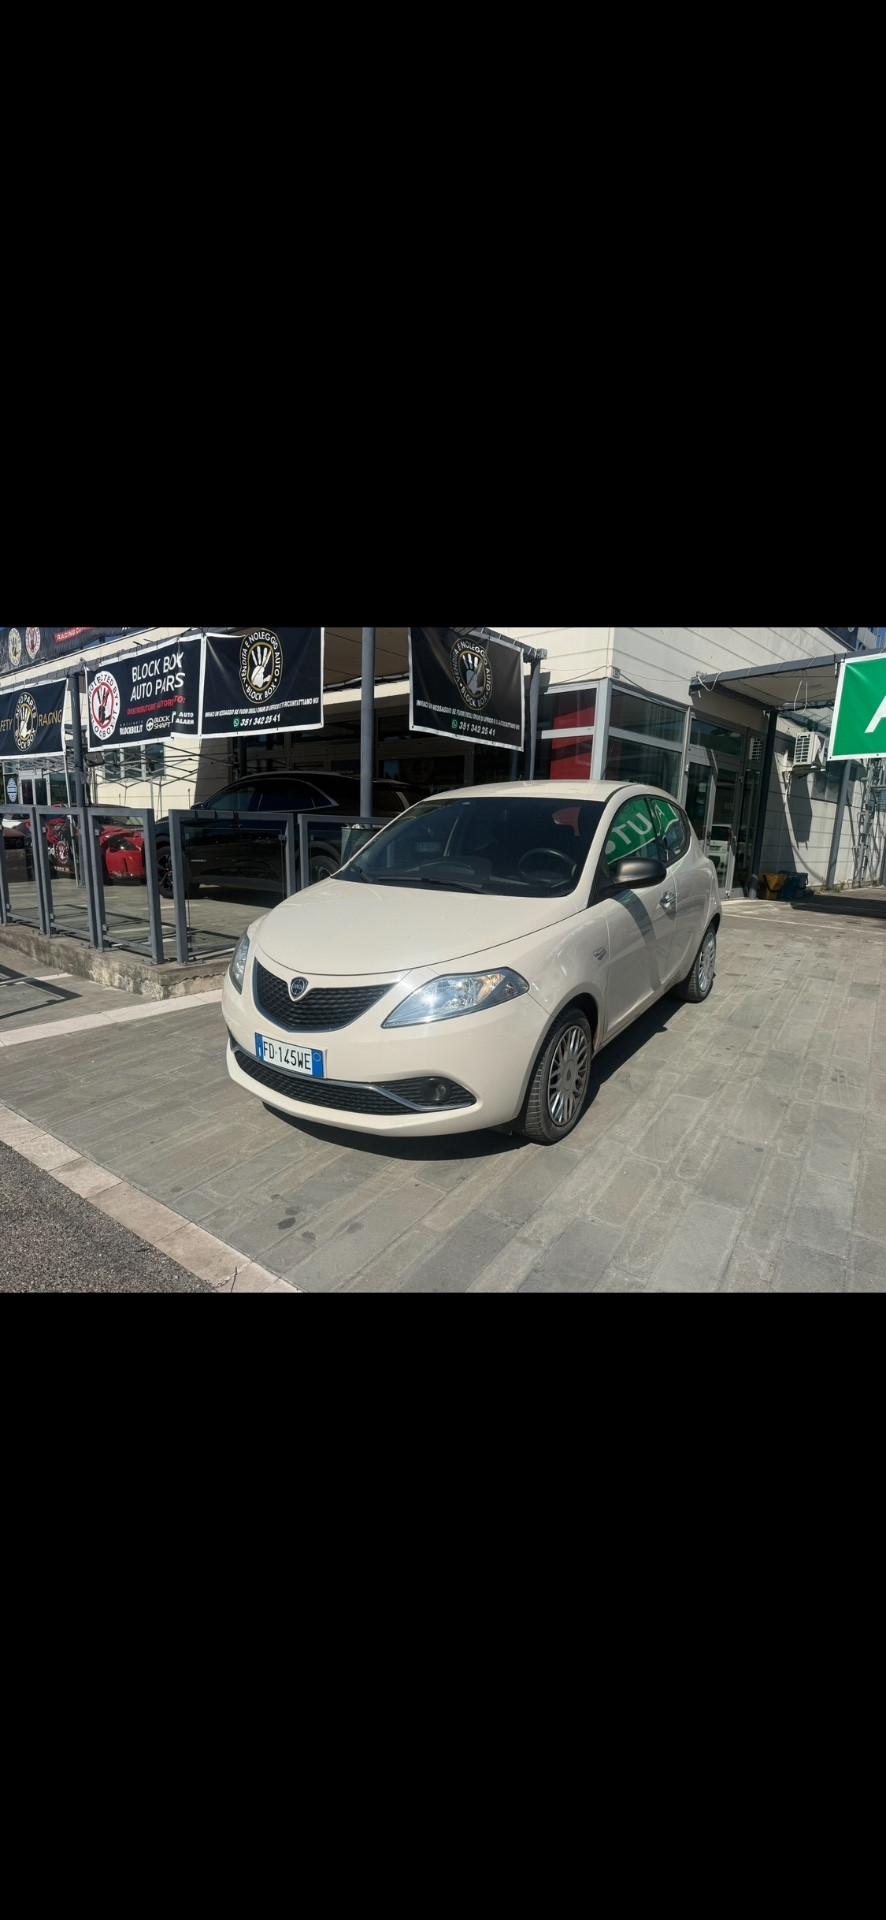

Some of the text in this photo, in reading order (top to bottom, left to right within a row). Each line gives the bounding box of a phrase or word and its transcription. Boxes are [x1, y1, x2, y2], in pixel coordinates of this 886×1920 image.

[248, 631, 278, 650] NOLEGGIO
[131, 658, 161, 683] BLOCK
[130, 681, 153, 702] AUTO
[246, 683, 277, 701] BLOCK BOX
[153, 722, 171, 730] SHAFT
[240, 718, 252, 727] 351
[253, 716, 265, 726] 342
[273, 713, 281, 722] 41
[458, 721, 470, 731] 351
[470, 723, 482, 734] 342
[489, 728, 496, 736] 41
